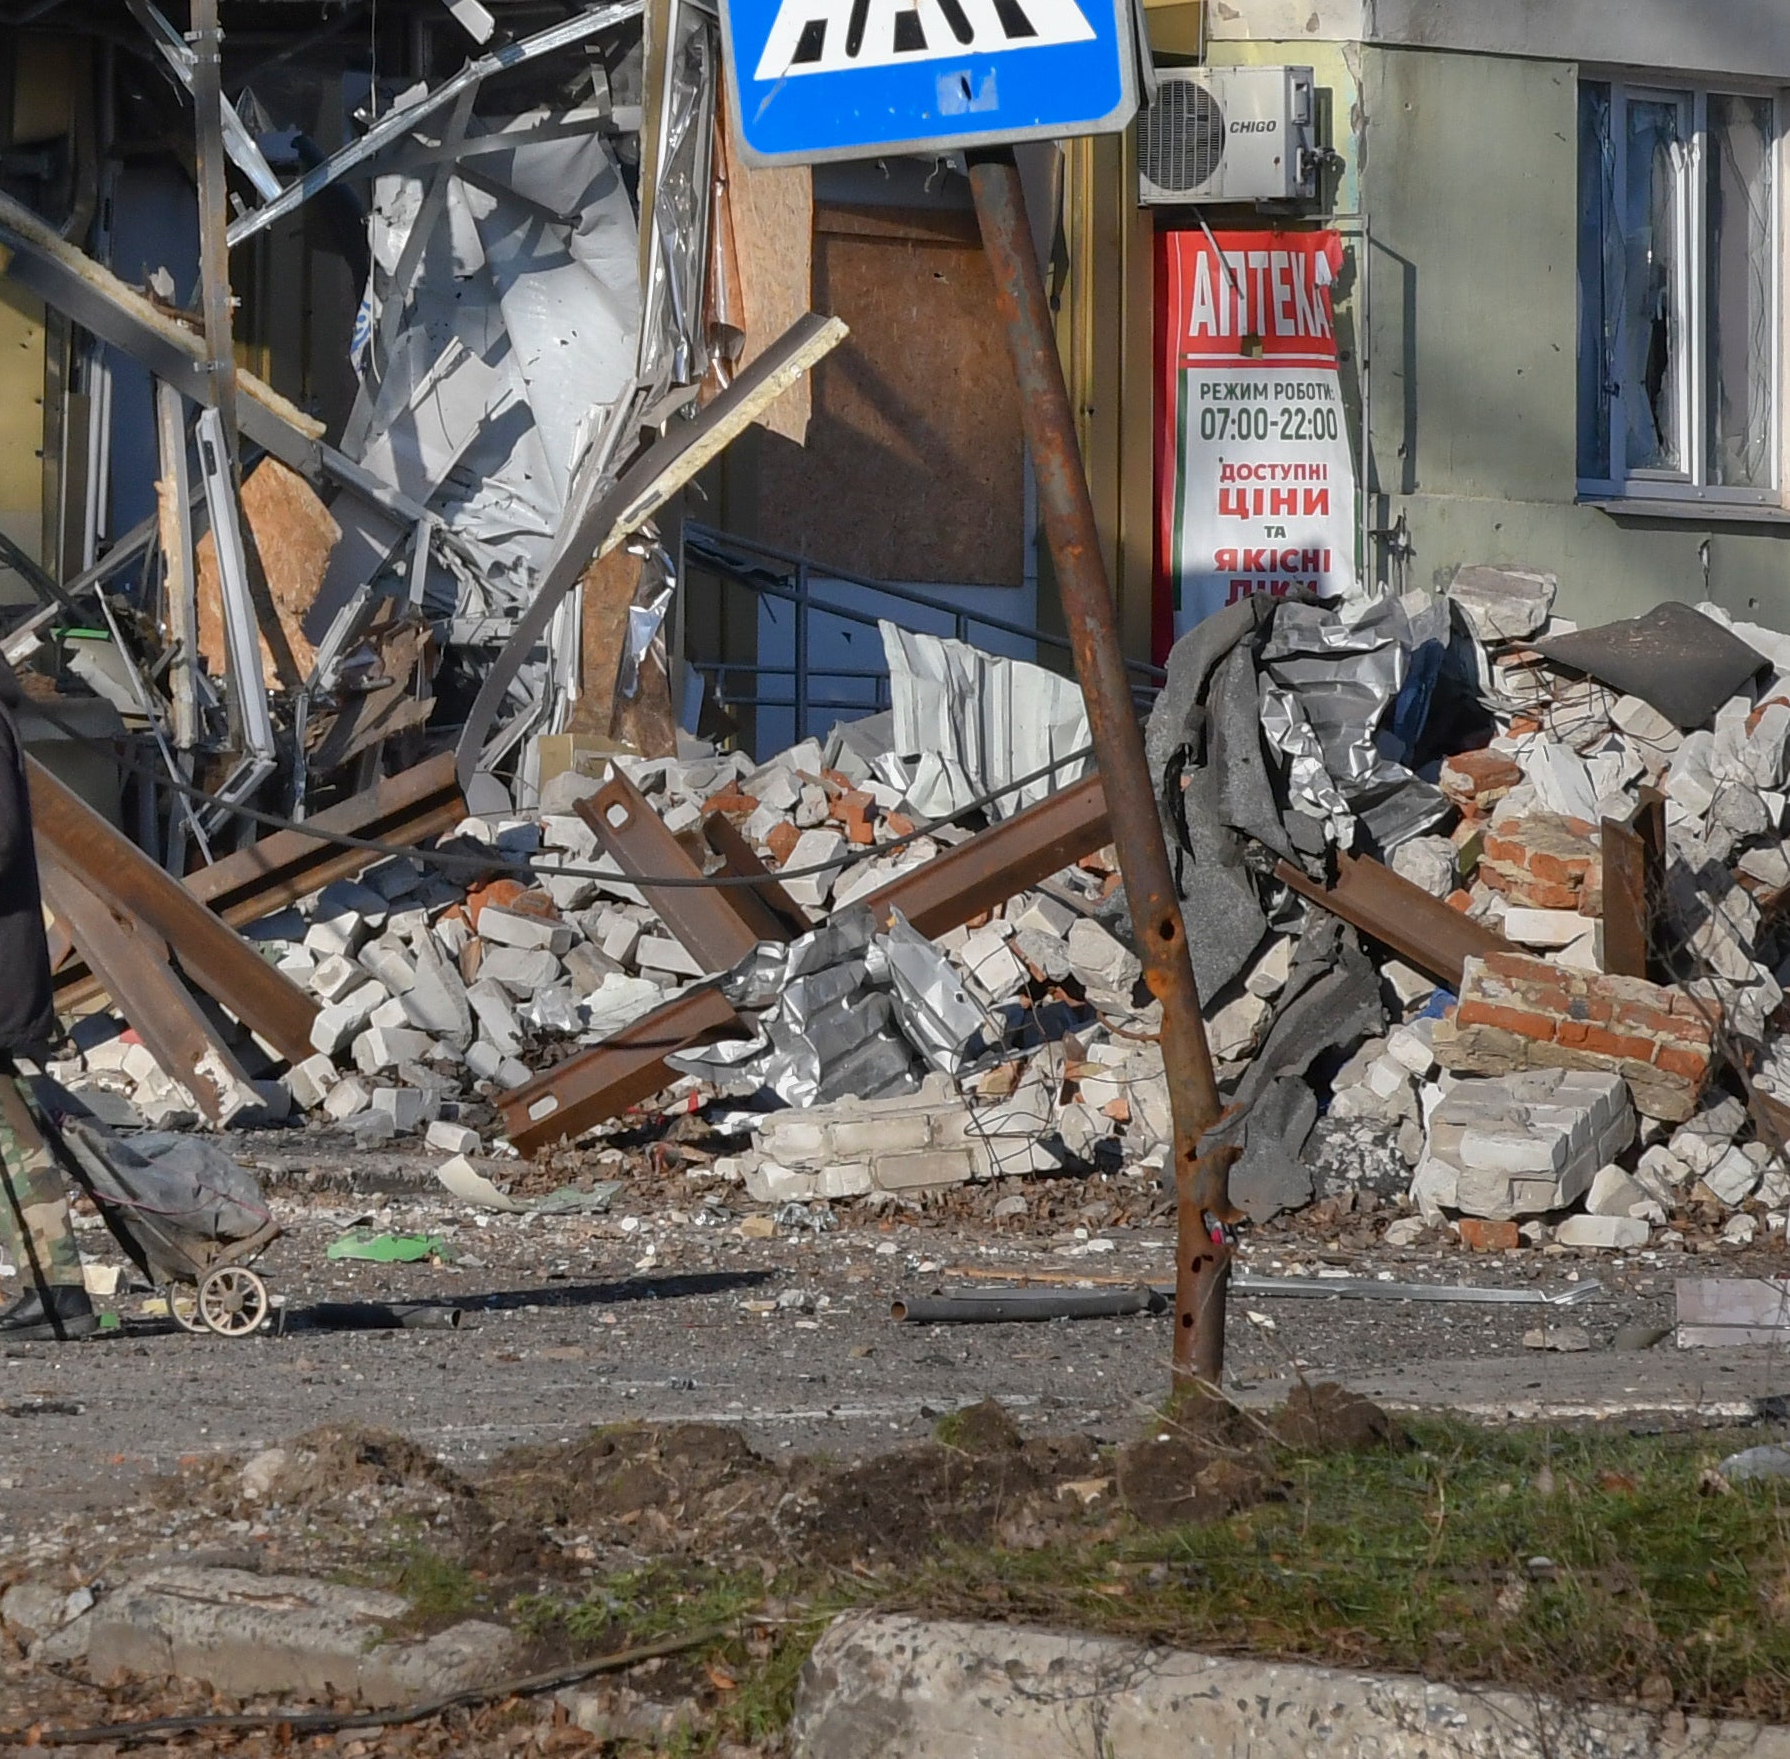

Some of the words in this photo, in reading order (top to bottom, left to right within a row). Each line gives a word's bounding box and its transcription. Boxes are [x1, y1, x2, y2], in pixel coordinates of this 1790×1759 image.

[1230, 120, 1277, 134] CHIGO
[1188, 251, 1333, 339] АПТЕКА
[1200, 382, 1269, 401] РЕЖИМ
[1274, 382, 1336, 402] РОБОТИ:
[1201, 407, 1338, 441] 07:00-22:00
[1219, 463, 1328, 483] ДОСТУПНІ
[1218, 488, 1329, 520] ЦІНИ
[1264, 525, 1287, 539] ТА
[1213, 548, 1332, 573] ЯКІСНІ
[1224, 579, 1318, 607] ЛК
